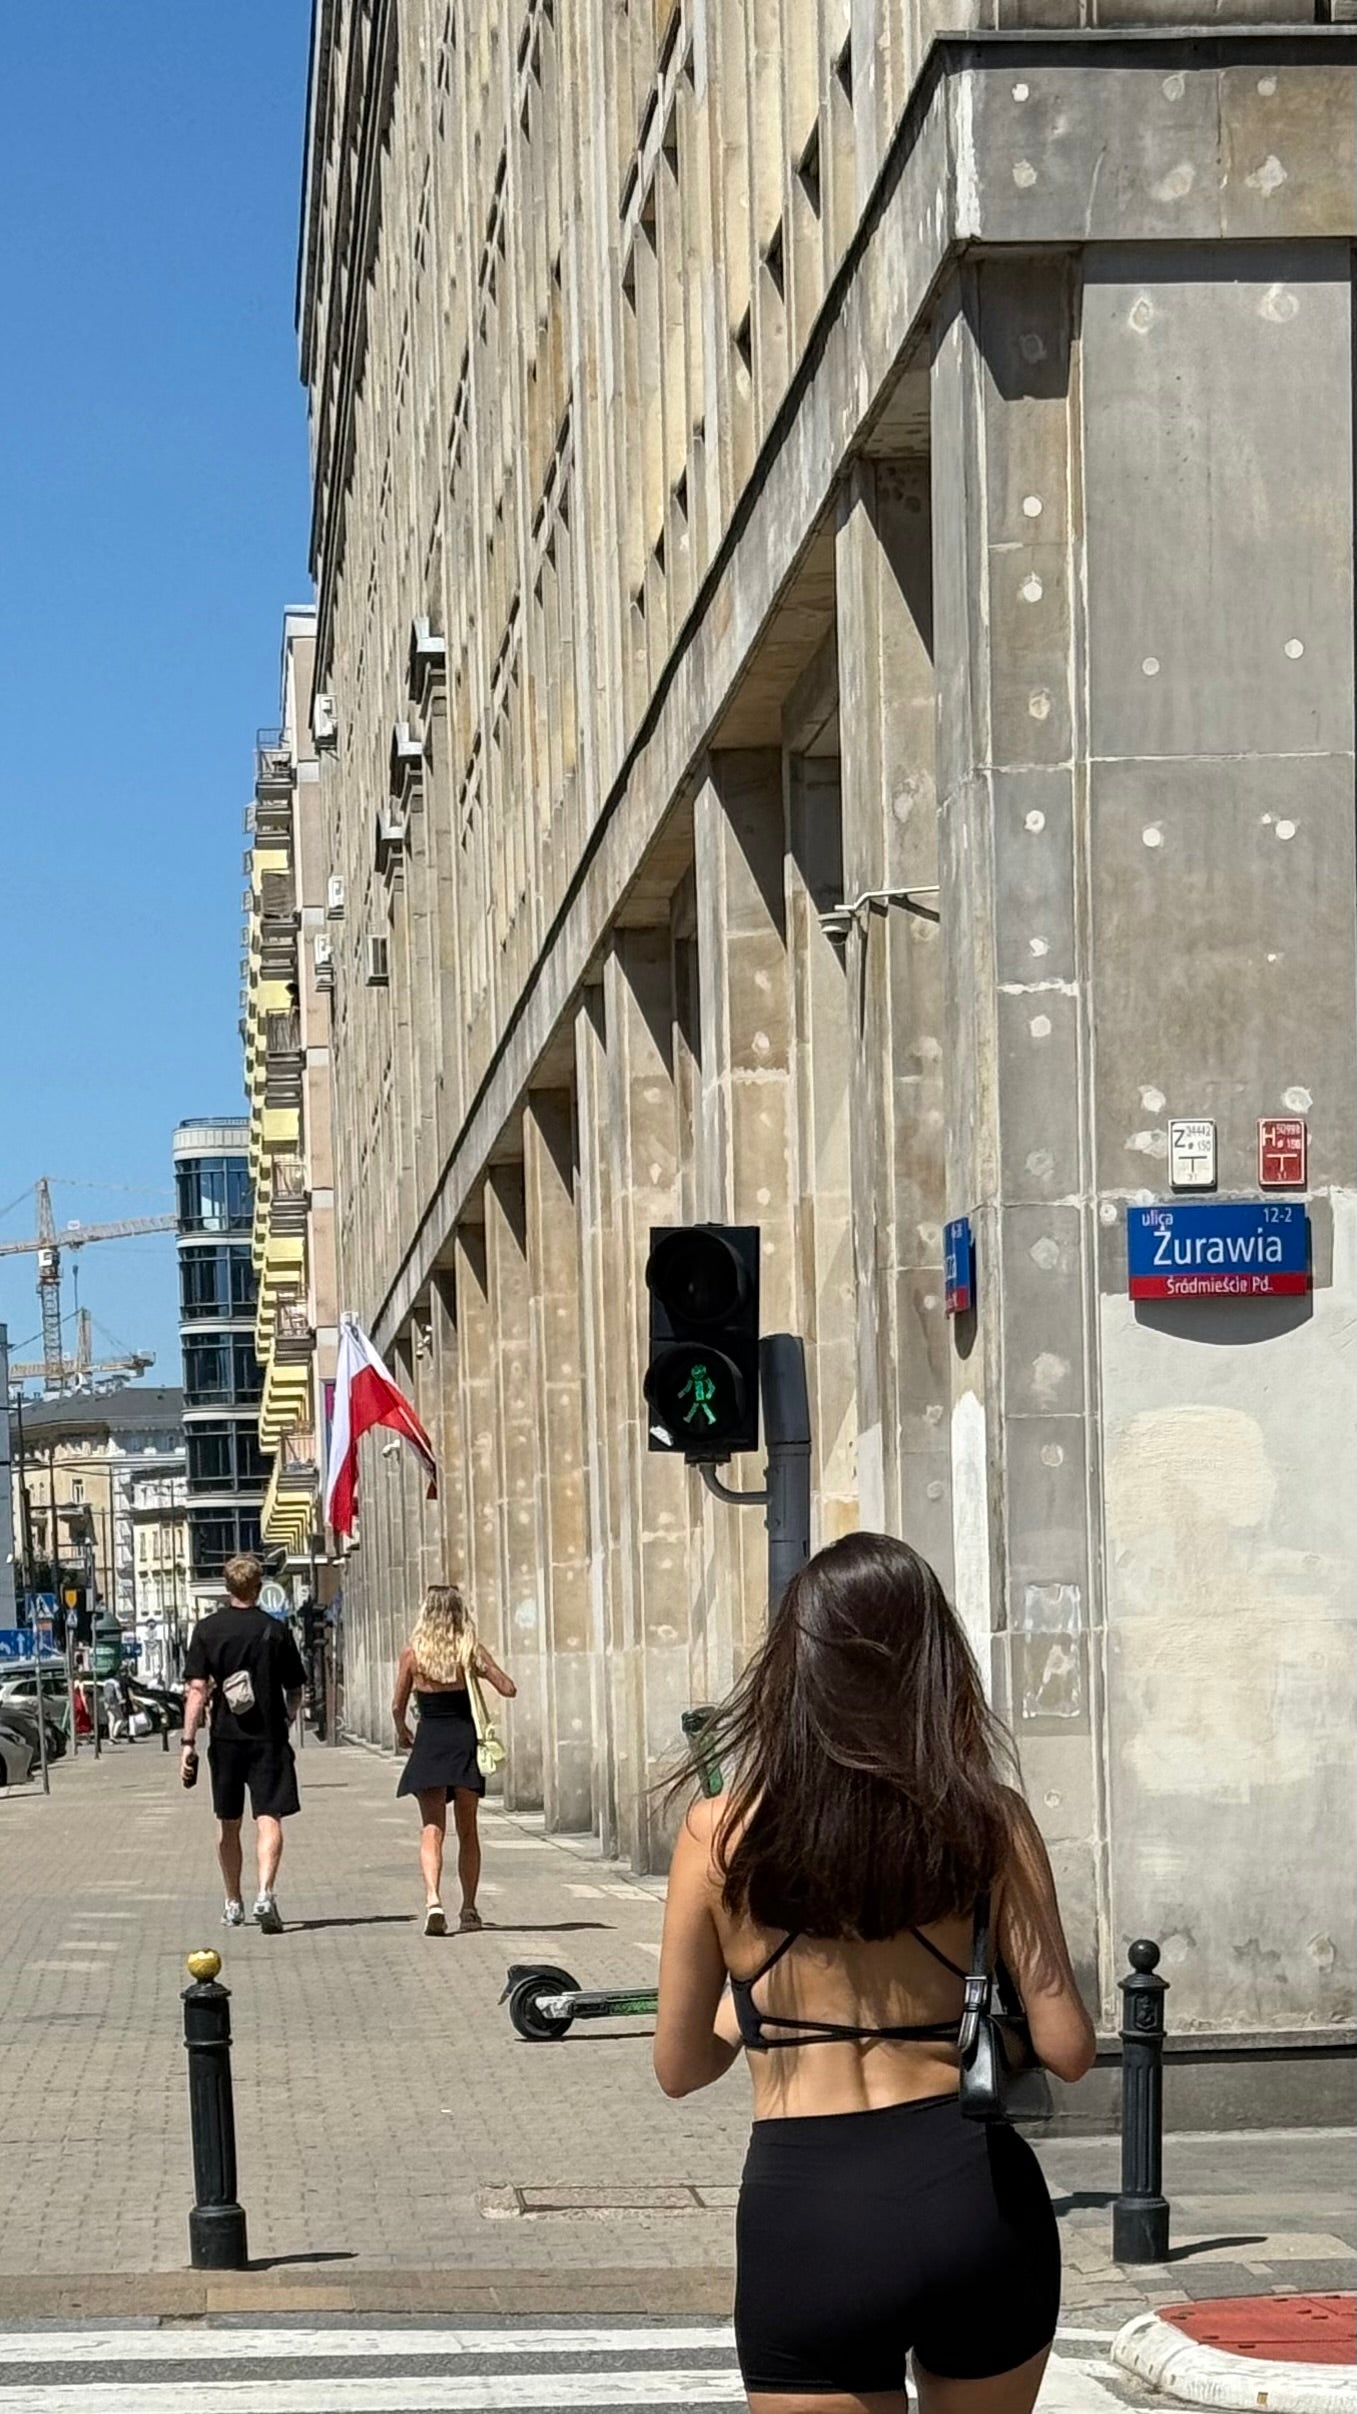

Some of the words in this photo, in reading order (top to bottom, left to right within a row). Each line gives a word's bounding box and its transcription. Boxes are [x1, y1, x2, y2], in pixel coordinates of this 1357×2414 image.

[1173, 1129, 1186, 1148] Z
[1262, 1127, 1276, 1147] H
[1142, 1209, 1174, 1227] ulica
[1263, 1207, 1292, 1223] 12-2
[1153, 1224, 1283, 1266] Żurawia
[1166, 1275, 1247, 1295] Śródmieście
[1252, 1275, 1273, 1292] Pd.
